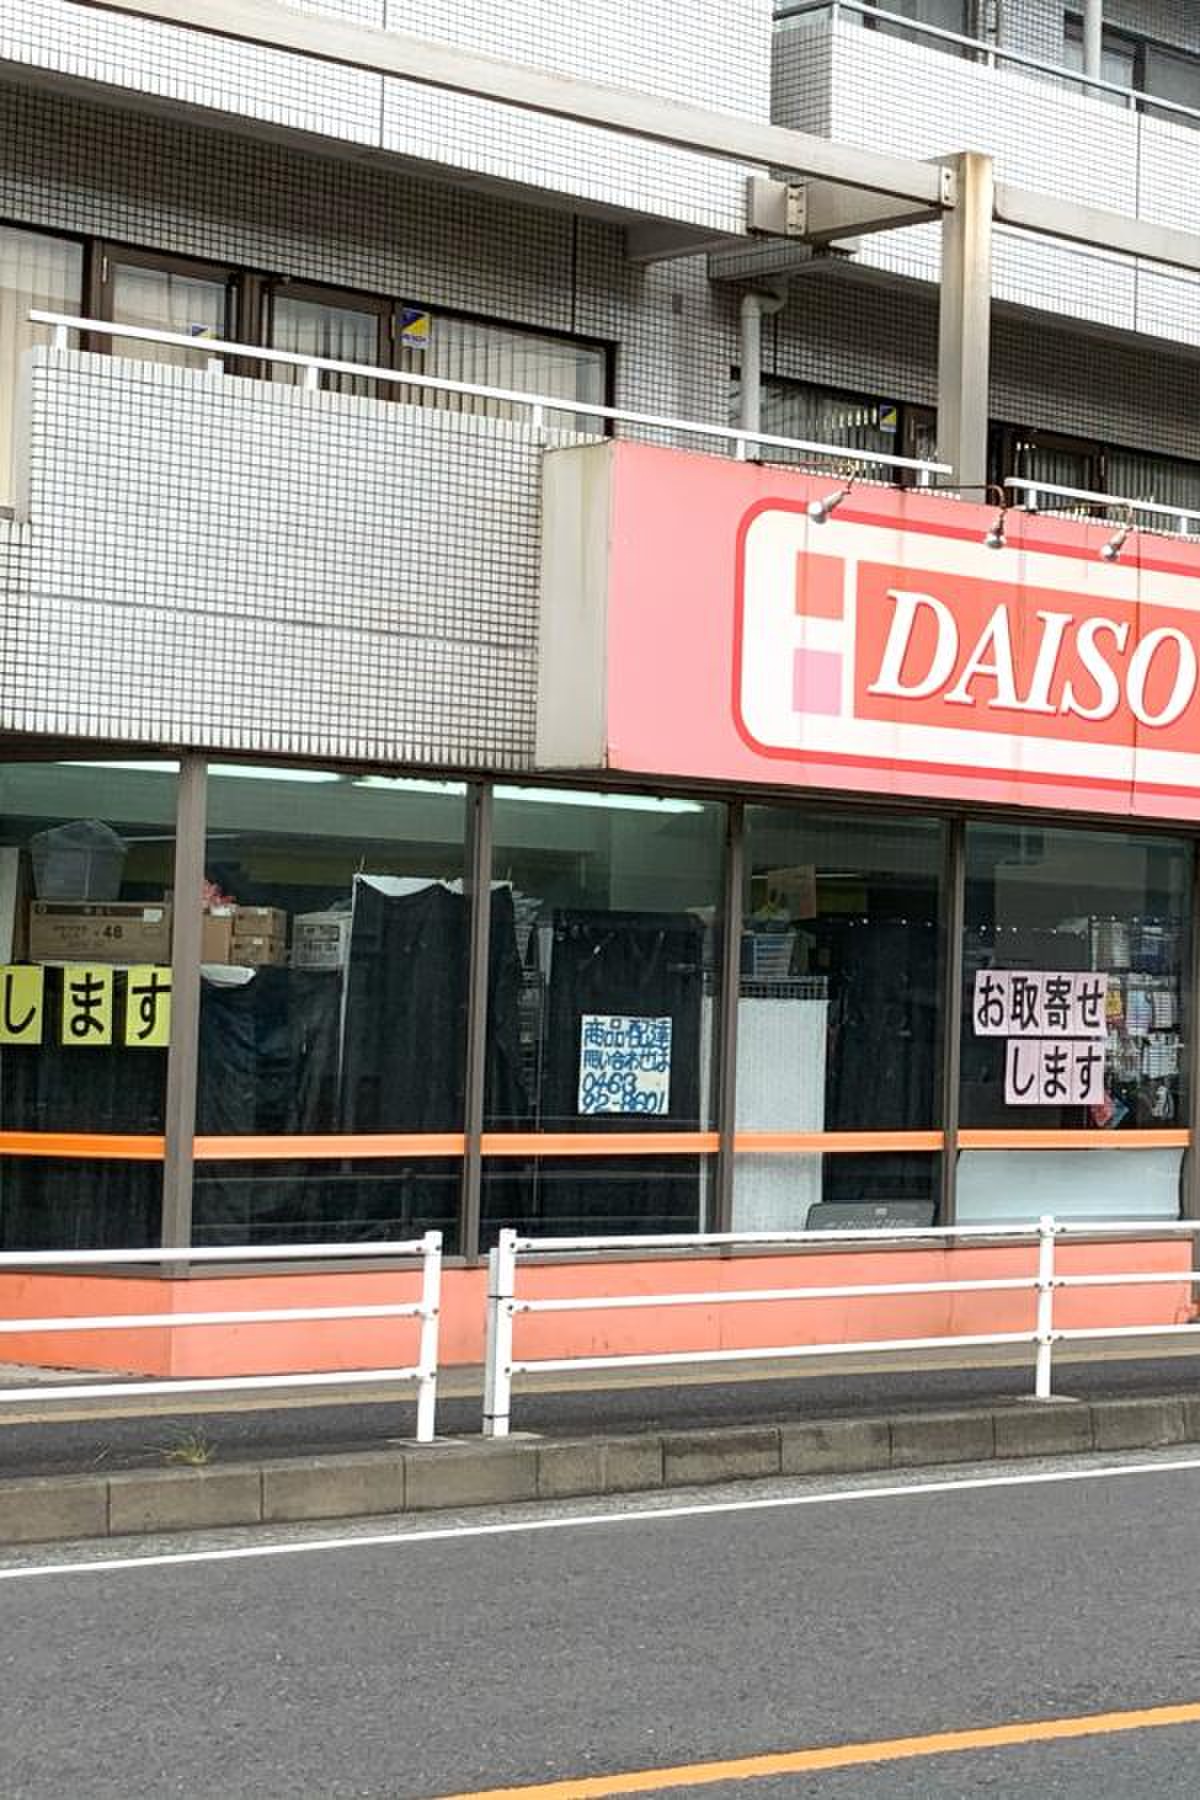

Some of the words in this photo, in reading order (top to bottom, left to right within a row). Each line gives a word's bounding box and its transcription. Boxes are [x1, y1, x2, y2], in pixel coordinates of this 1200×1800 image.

[866, 588, 1198, 727] DAISO
[4, 972, 172, 1039] します
[977, 976, 1104, 1030] お取寄せ
[1012, 1045, 1102, 1099] します
